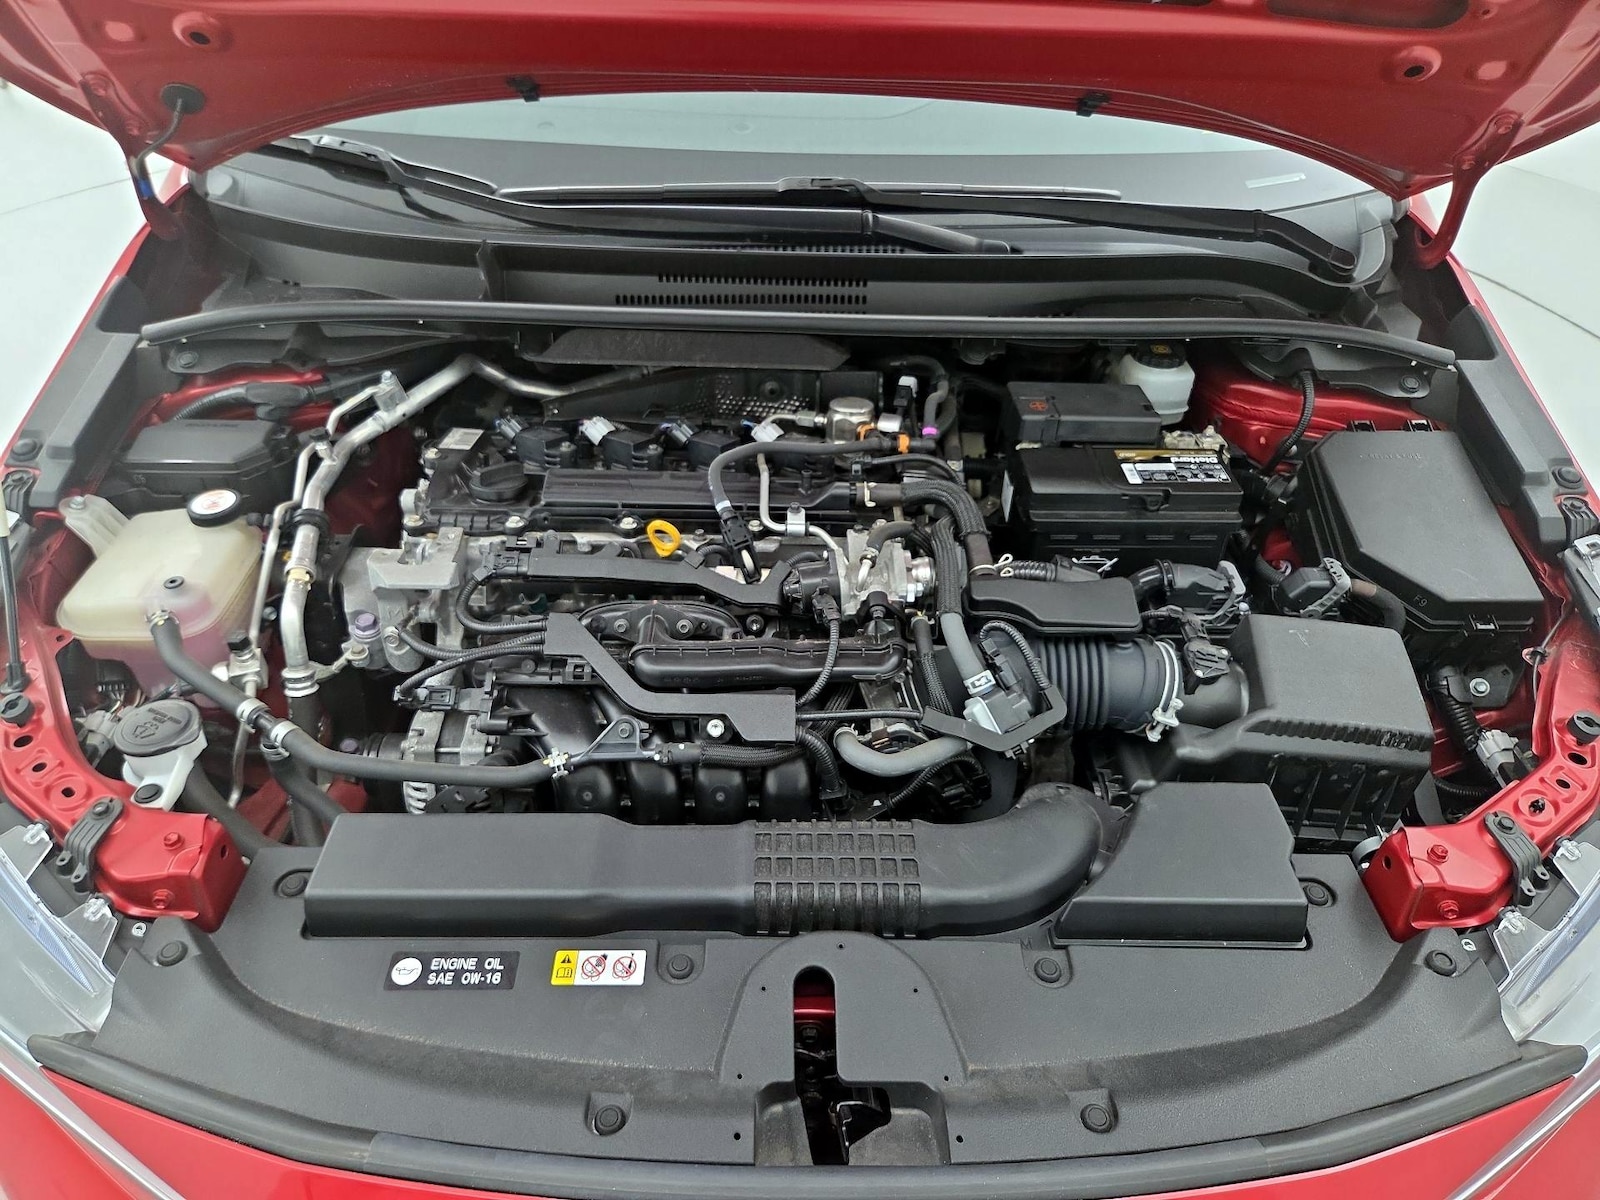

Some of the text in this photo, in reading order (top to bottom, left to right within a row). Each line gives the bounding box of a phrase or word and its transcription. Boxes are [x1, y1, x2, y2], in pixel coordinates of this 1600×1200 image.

[430, 957, 504, 970] ENGINE OIL
[426, 972, 502, 985] SAE 0W-16
